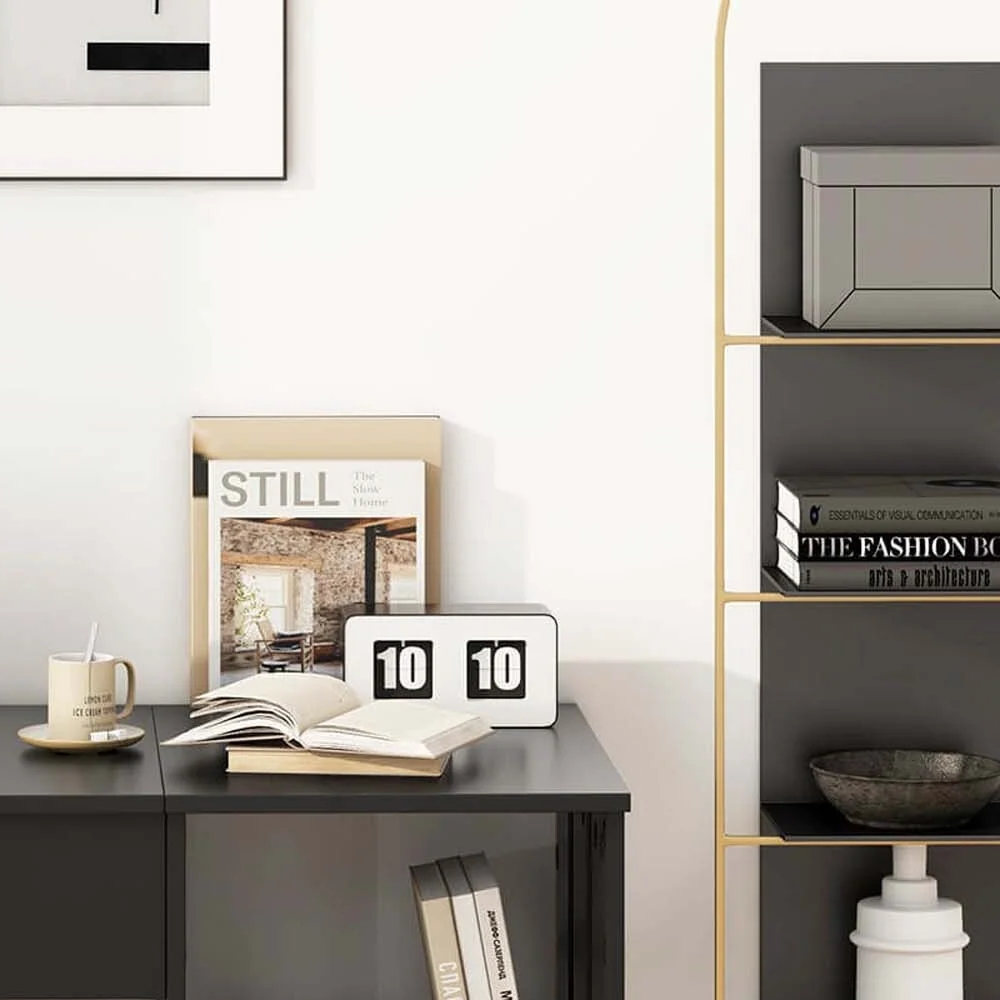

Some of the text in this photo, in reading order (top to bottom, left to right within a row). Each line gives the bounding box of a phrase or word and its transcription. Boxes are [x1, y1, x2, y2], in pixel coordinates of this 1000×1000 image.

[354, 471, 376, 482] The
[220, 471, 341, 507] STILL
[828, 509, 874, 521] ESSENTIALS
[876, 509, 887, 521] OF
[888, 509, 916, 521] VISUAL
[917, 509, 984, 521] COMMUNICATION
[801, 536, 853, 558] THE
[859, 536, 967, 558] FASHION
[869, 565, 893, 588] arts
[914, 563, 990, 588] architecture
[376, 645, 521, 691] 10 10
